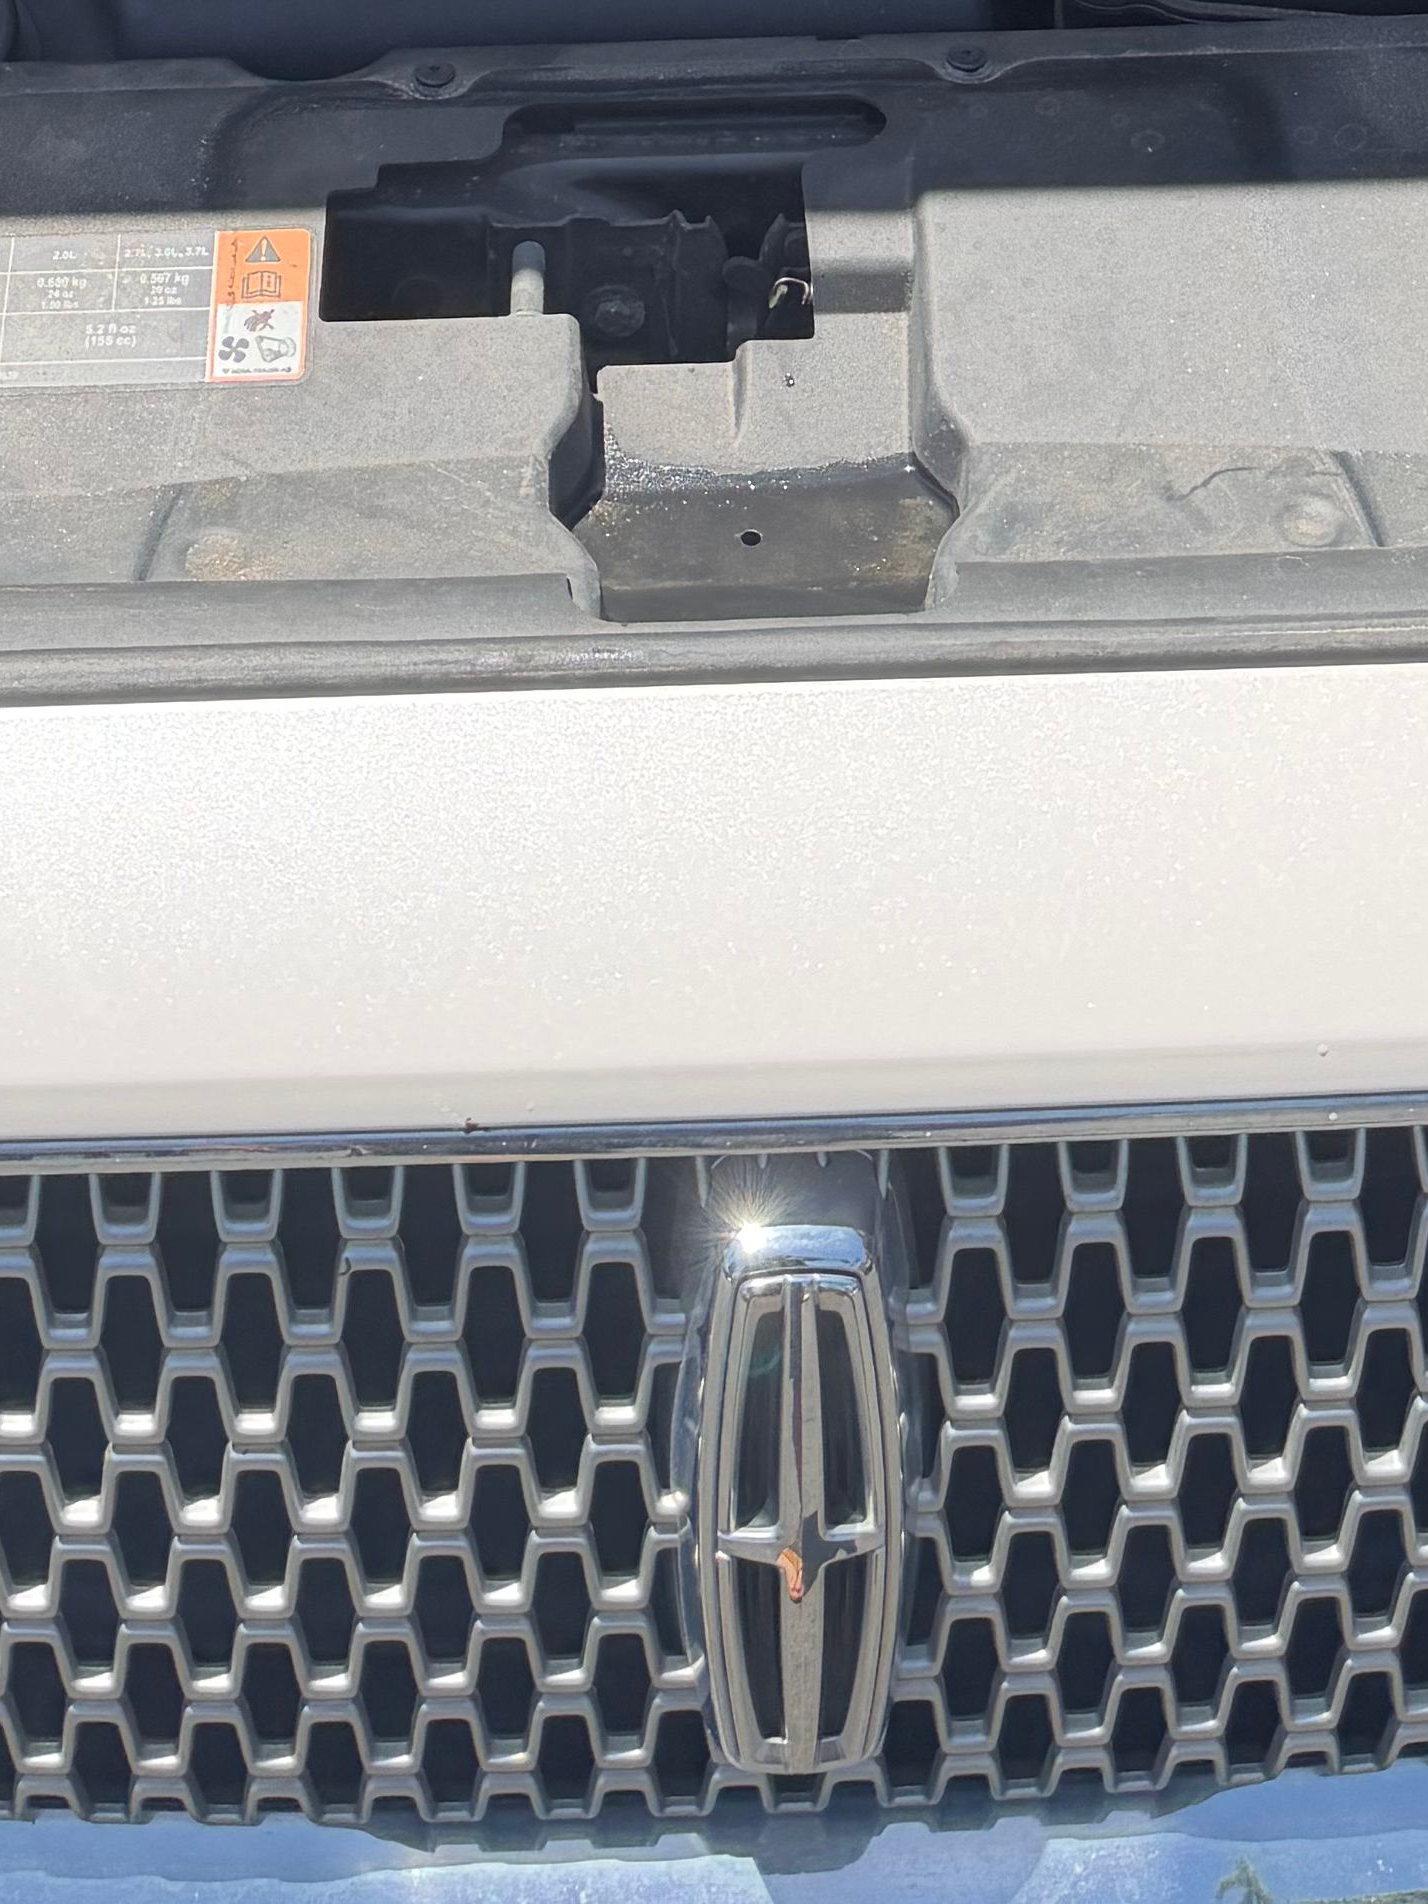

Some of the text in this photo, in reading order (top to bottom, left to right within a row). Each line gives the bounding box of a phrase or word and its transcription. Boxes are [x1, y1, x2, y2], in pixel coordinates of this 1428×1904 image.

[52, 250, 76, 261] 2.0L
[72, 277, 87, 290] kg
[174, 273, 189, 286] kg
[85, 322, 138, 334] 5.2 fl oz
[84, 335, 137, 349] (155 cc)
